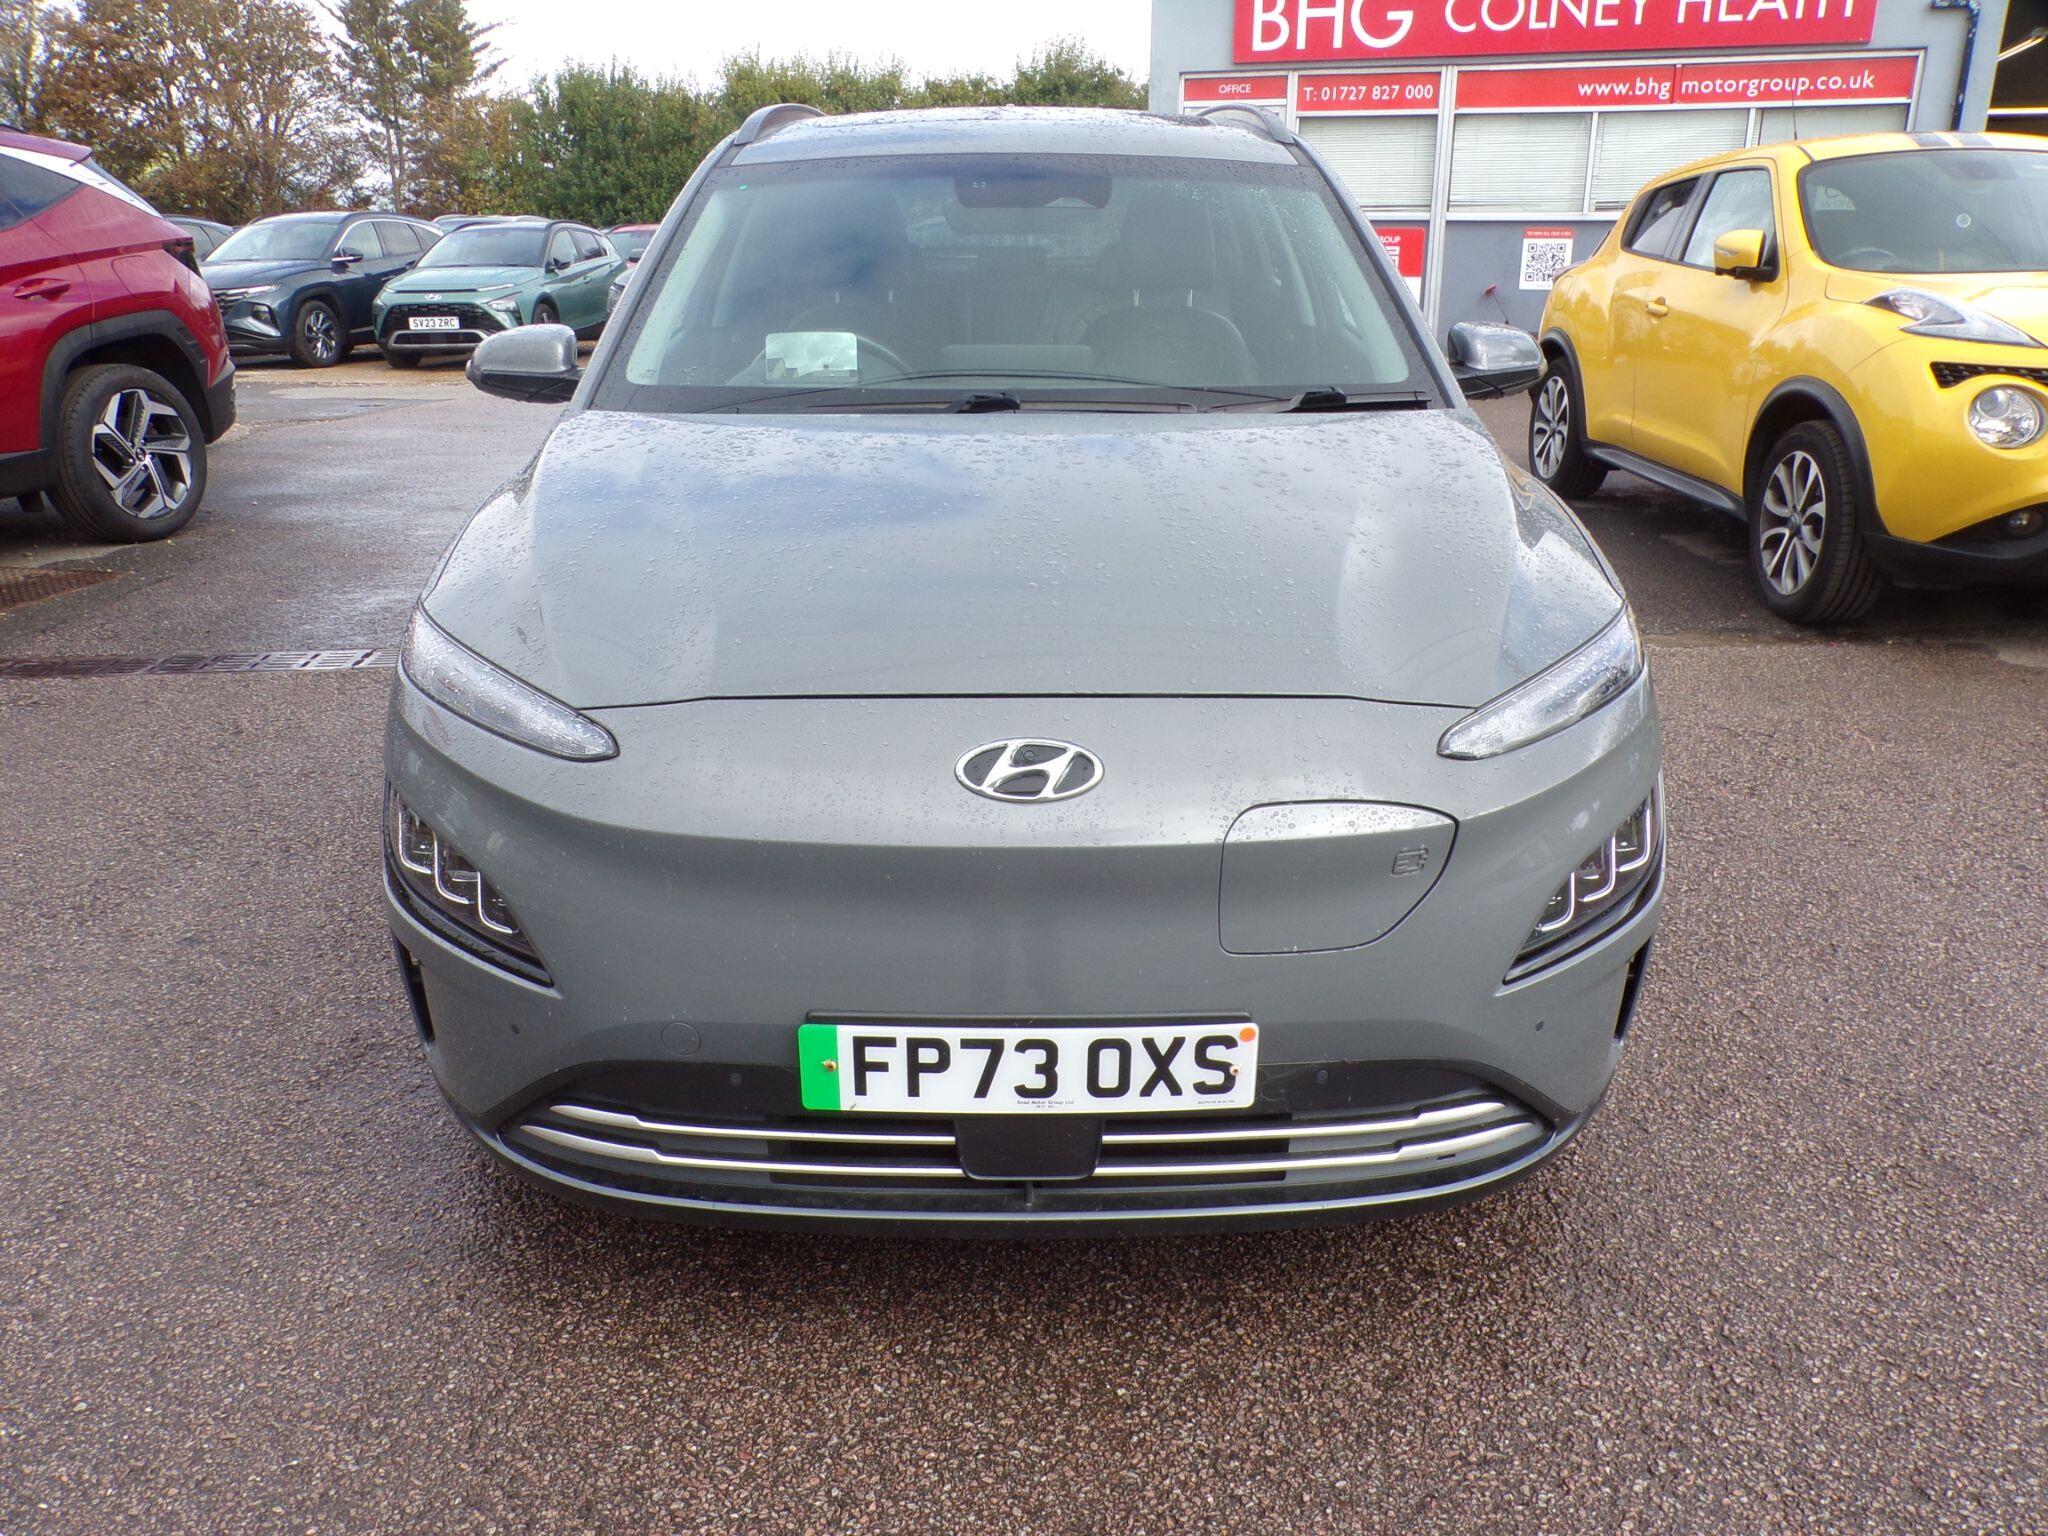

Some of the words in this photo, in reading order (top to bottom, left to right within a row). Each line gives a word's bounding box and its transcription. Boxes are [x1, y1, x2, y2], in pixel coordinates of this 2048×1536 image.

[1252, 0, 1414, 50] BHG
[1445, 0, 1647, 32] COLNEY
[1218, 83, 1252, 94] OFFICE
[1303, 87, 1318, 101] T:
[1321, 86, 1367, 101] 01727
[1372, 85, 1400, 100] 827
[1405, 84, 1434, 99] 000
[412, 318, 436, 328] SV23
[438, 317, 456, 327] ZRC
[852, 1036, 1059, 1098] FP73
[1086, 1035, 1239, 1098] OXS
